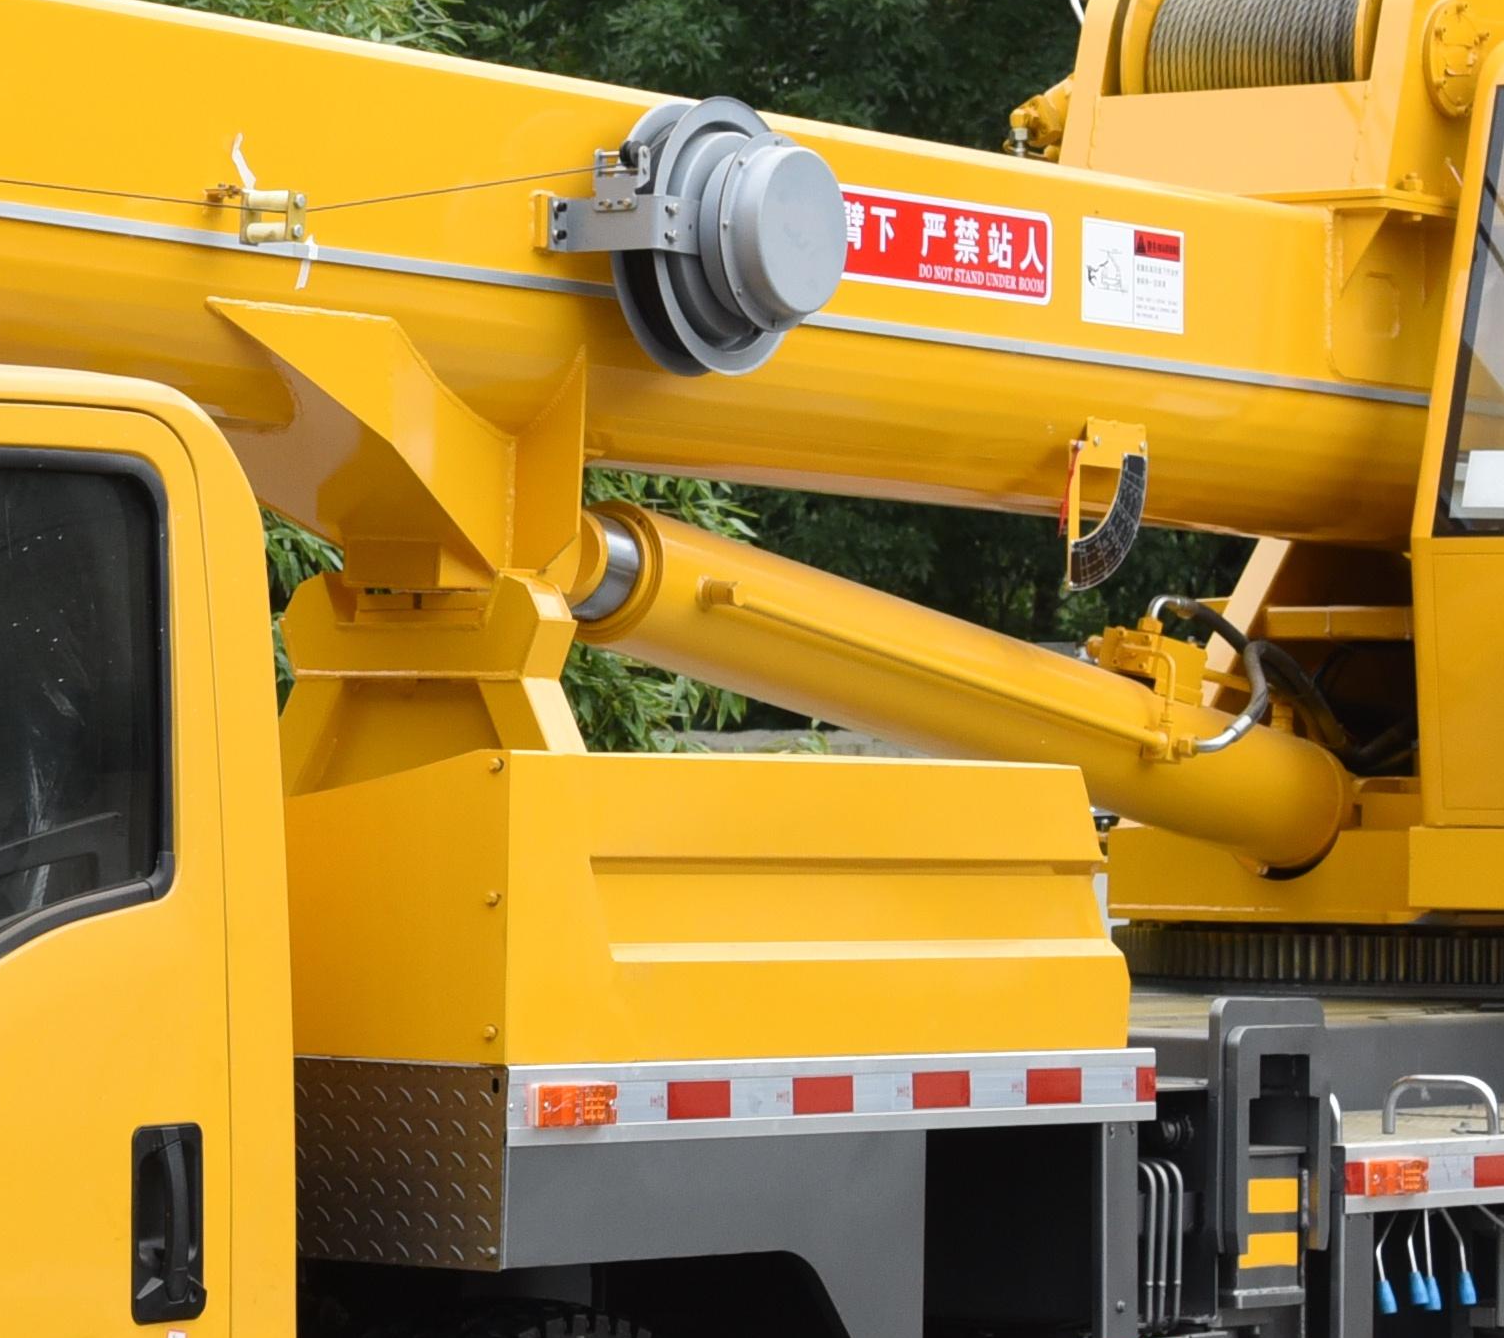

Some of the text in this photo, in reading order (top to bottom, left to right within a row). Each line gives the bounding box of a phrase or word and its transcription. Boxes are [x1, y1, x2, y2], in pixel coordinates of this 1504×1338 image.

[921, 212, 1045, 273] 严禁站人
[918, 263, 1045, 293] DO NOT STAND UNDER BOOM
